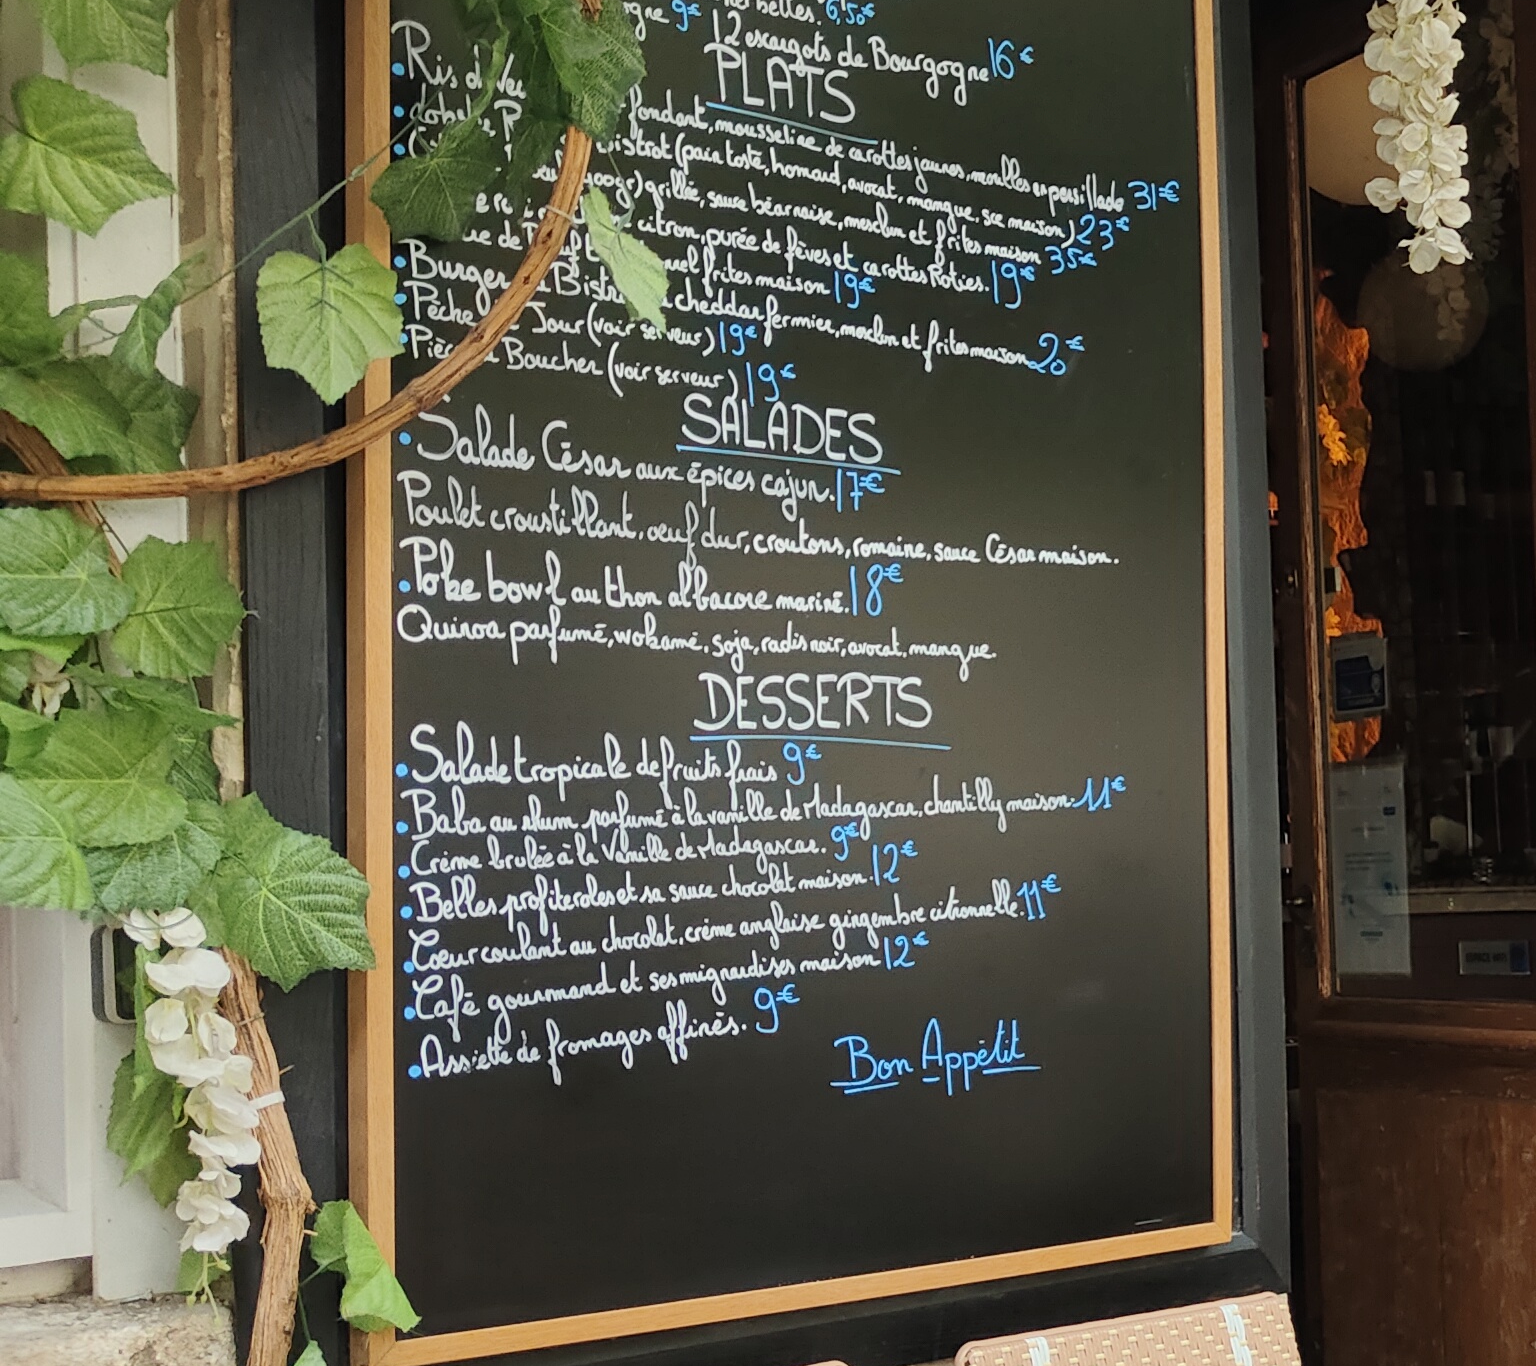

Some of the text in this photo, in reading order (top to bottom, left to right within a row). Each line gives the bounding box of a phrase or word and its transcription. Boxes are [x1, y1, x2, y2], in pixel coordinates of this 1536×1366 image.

[704, 43, 856, 123] PLATS
[712, 9, 1034, 107] 12 de Bourgogne 16€
[715, 119, 822, 152] mousseline
[824, 136, 844, 158] de
[849, 139, 911, 172] carottes
[1128, 180, 1180, 211] 31€
[498, 219, 876, 309] de frites maison 19€
[707, 190, 749, 212] sauce
[909, 219, 931, 245] et
[935, 219, 982, 267] frites
[985, 242, 1041, 264] maison
[1045, 245, 1097, 275] 35€
[761, 229, 1035, 309] de et carottes 19€
[1077, 213, 1130, 251] 23€
[398, 238, 1085, 376] Burger cheddar et maison 20€
[719, 320, 758, 356] 19€
[501, 336, 797, 408] Boucher 19€
[416, 395, 535, 471] Salade
[635, 460, 684, 482] aux
[836, 468, 885, 513] 17€
[681, 392, 883, 464] SALADES
[397, 470, 485, 529] Poulet
[934, 542, 981, 564] sauce
[399, 536, 904, 617] Poke bowl au thon albacore 18€
[397, 603, 507, 642] Quinoa
[693, 672, 933, 731] DESSERTS
[410, 720, 822, 801] Salade tropicale de 9€
[400, 774, 1126, 840] Baba au vanille de chantilly 11€
[602, 834, 673, 865] Vanille
[675, 835, 697, 863] de
[830, 821, 860, 861] 9€
[408, 874, 497, 923] Belles
[499, 872, 616, 936] profiteroles
[669, 881, 717, 901] sauce
[871, 840, 918, 888] 12€
[480, 873, 1061, 963] coulant au anglaise gingembre 11€
[413, 931, 930, 1044] Café gourmand et ses mignardises maison 12€
[419, 983, 800, 1087] Assiette de fromages 9€
[834, 1018, 1025, 1096] Bon Appétit
